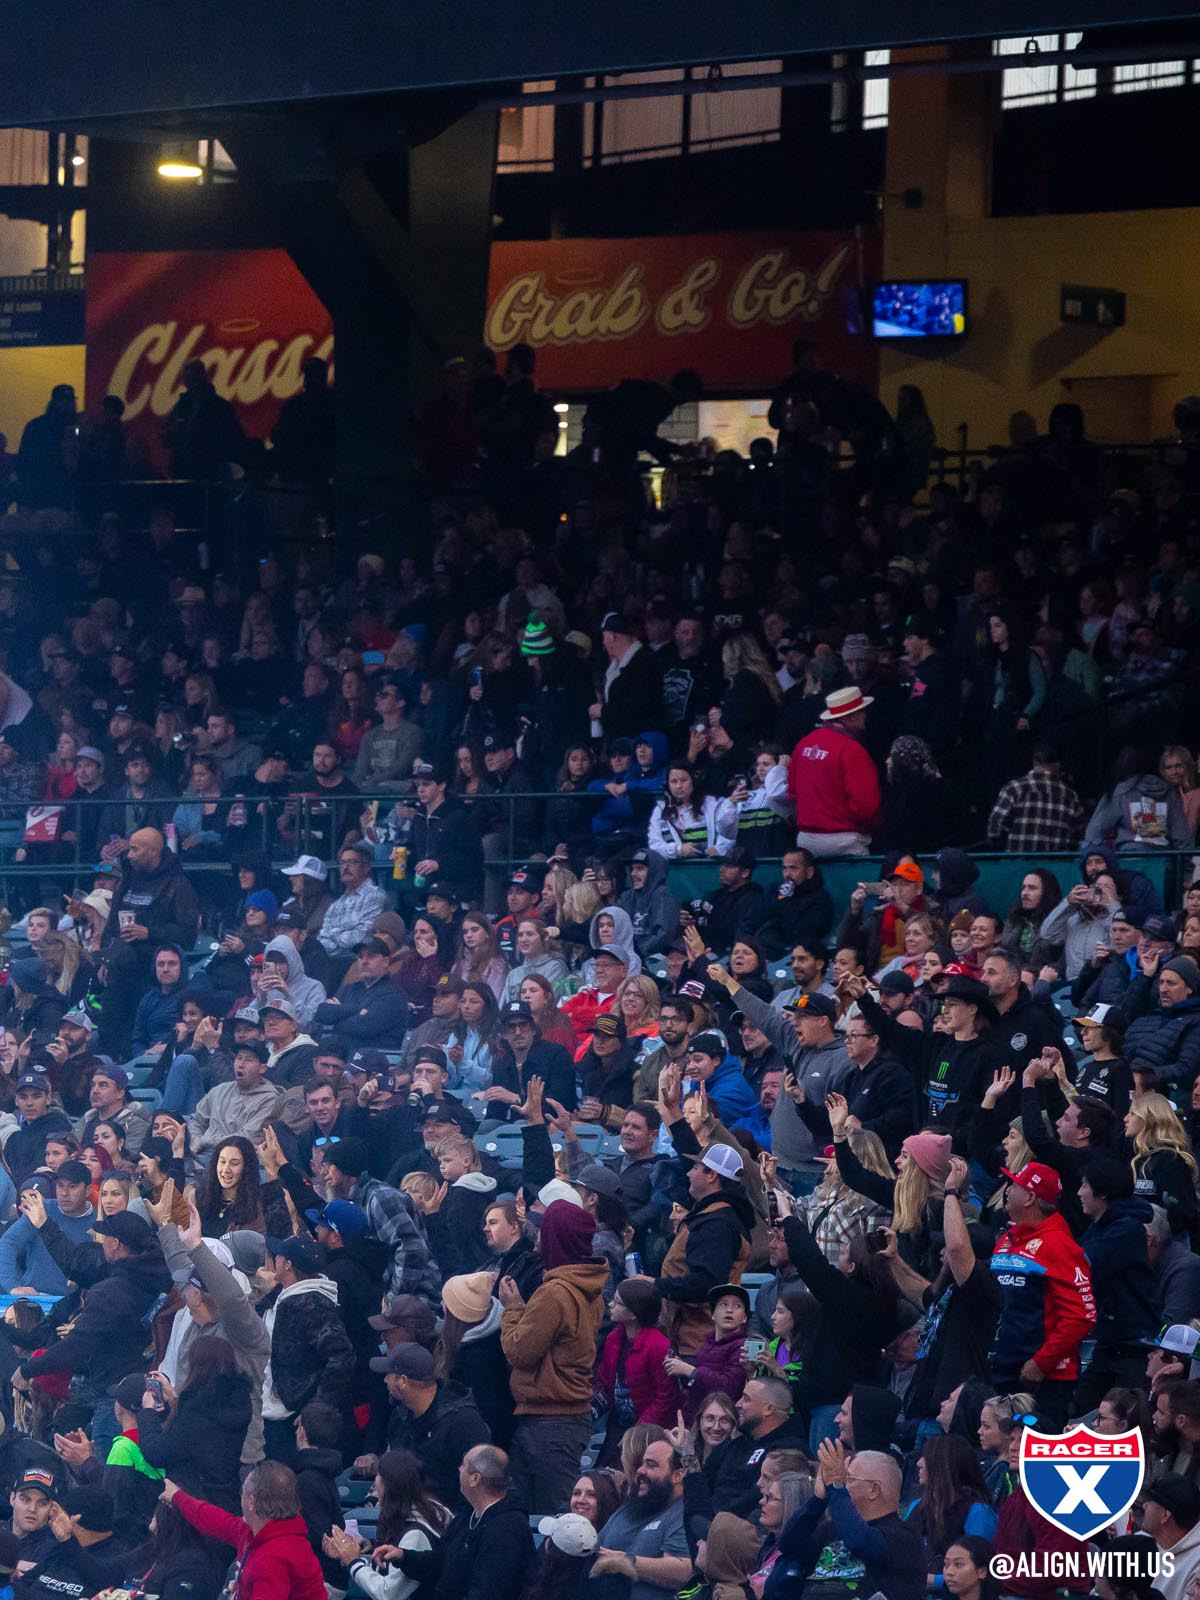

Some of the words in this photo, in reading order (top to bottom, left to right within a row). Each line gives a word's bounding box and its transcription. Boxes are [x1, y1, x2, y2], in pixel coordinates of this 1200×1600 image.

[488, 265, 648, 348] Grab
[657, 260, 720, 332] &
[732, 246, 850, 326] Go!
